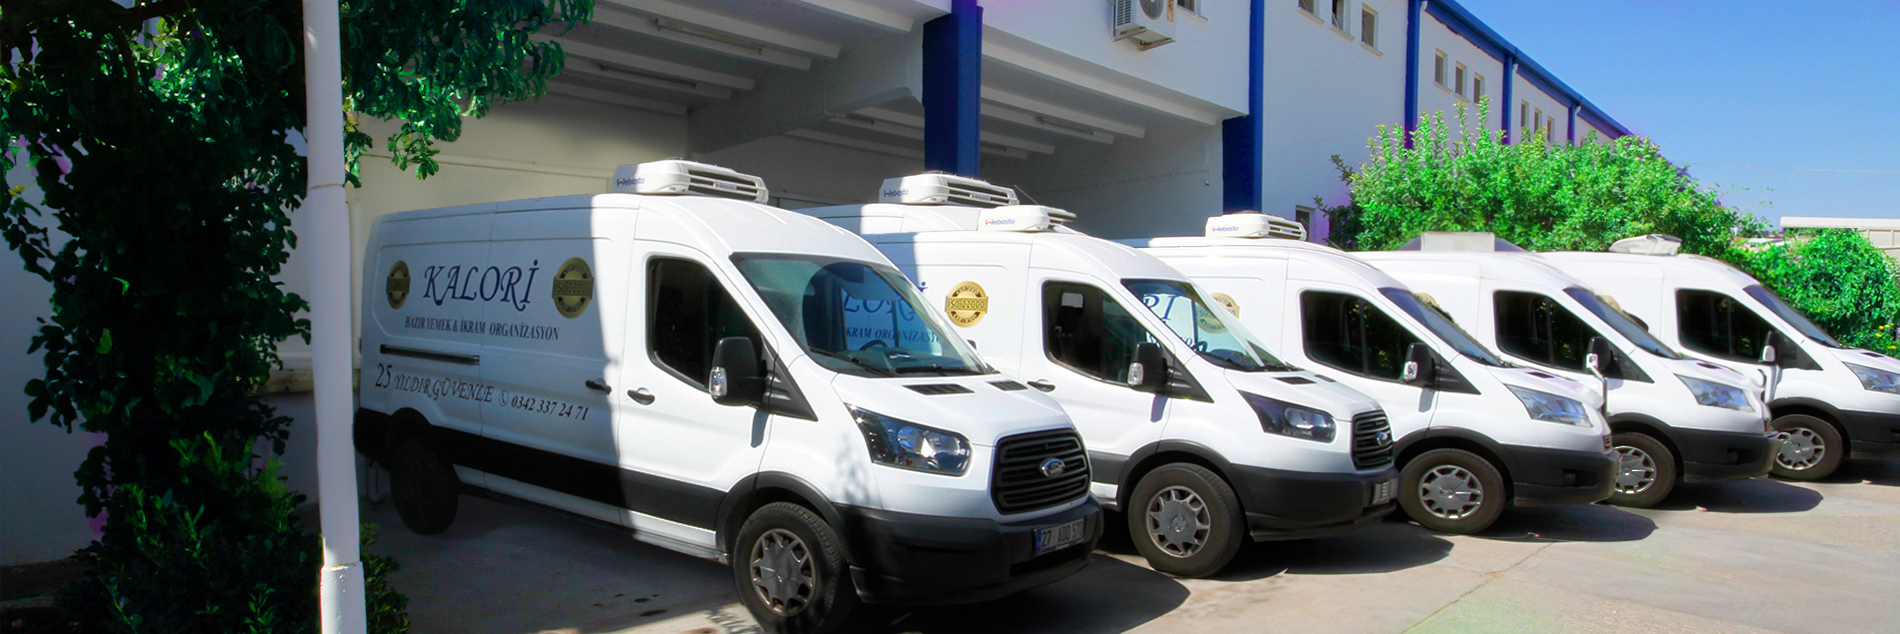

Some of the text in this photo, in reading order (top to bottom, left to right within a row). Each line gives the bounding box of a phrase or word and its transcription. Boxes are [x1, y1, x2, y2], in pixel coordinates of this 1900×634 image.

[423, 259, 540, 312] KALORİ
[404, 316, 561, 341] HAZIR YEMEK & İKRAM ORGANİZASYON
[846, 327, 872, 339] KRAM
[375, 363, 393, 388] 25
[511, 395, 536, 411] 0342
[536, 399, 557, 415] 337
[558, 403, 574, 417] 24
[575, 405, 589, 420] 71
[1041, 529, 1052, 547] 27
